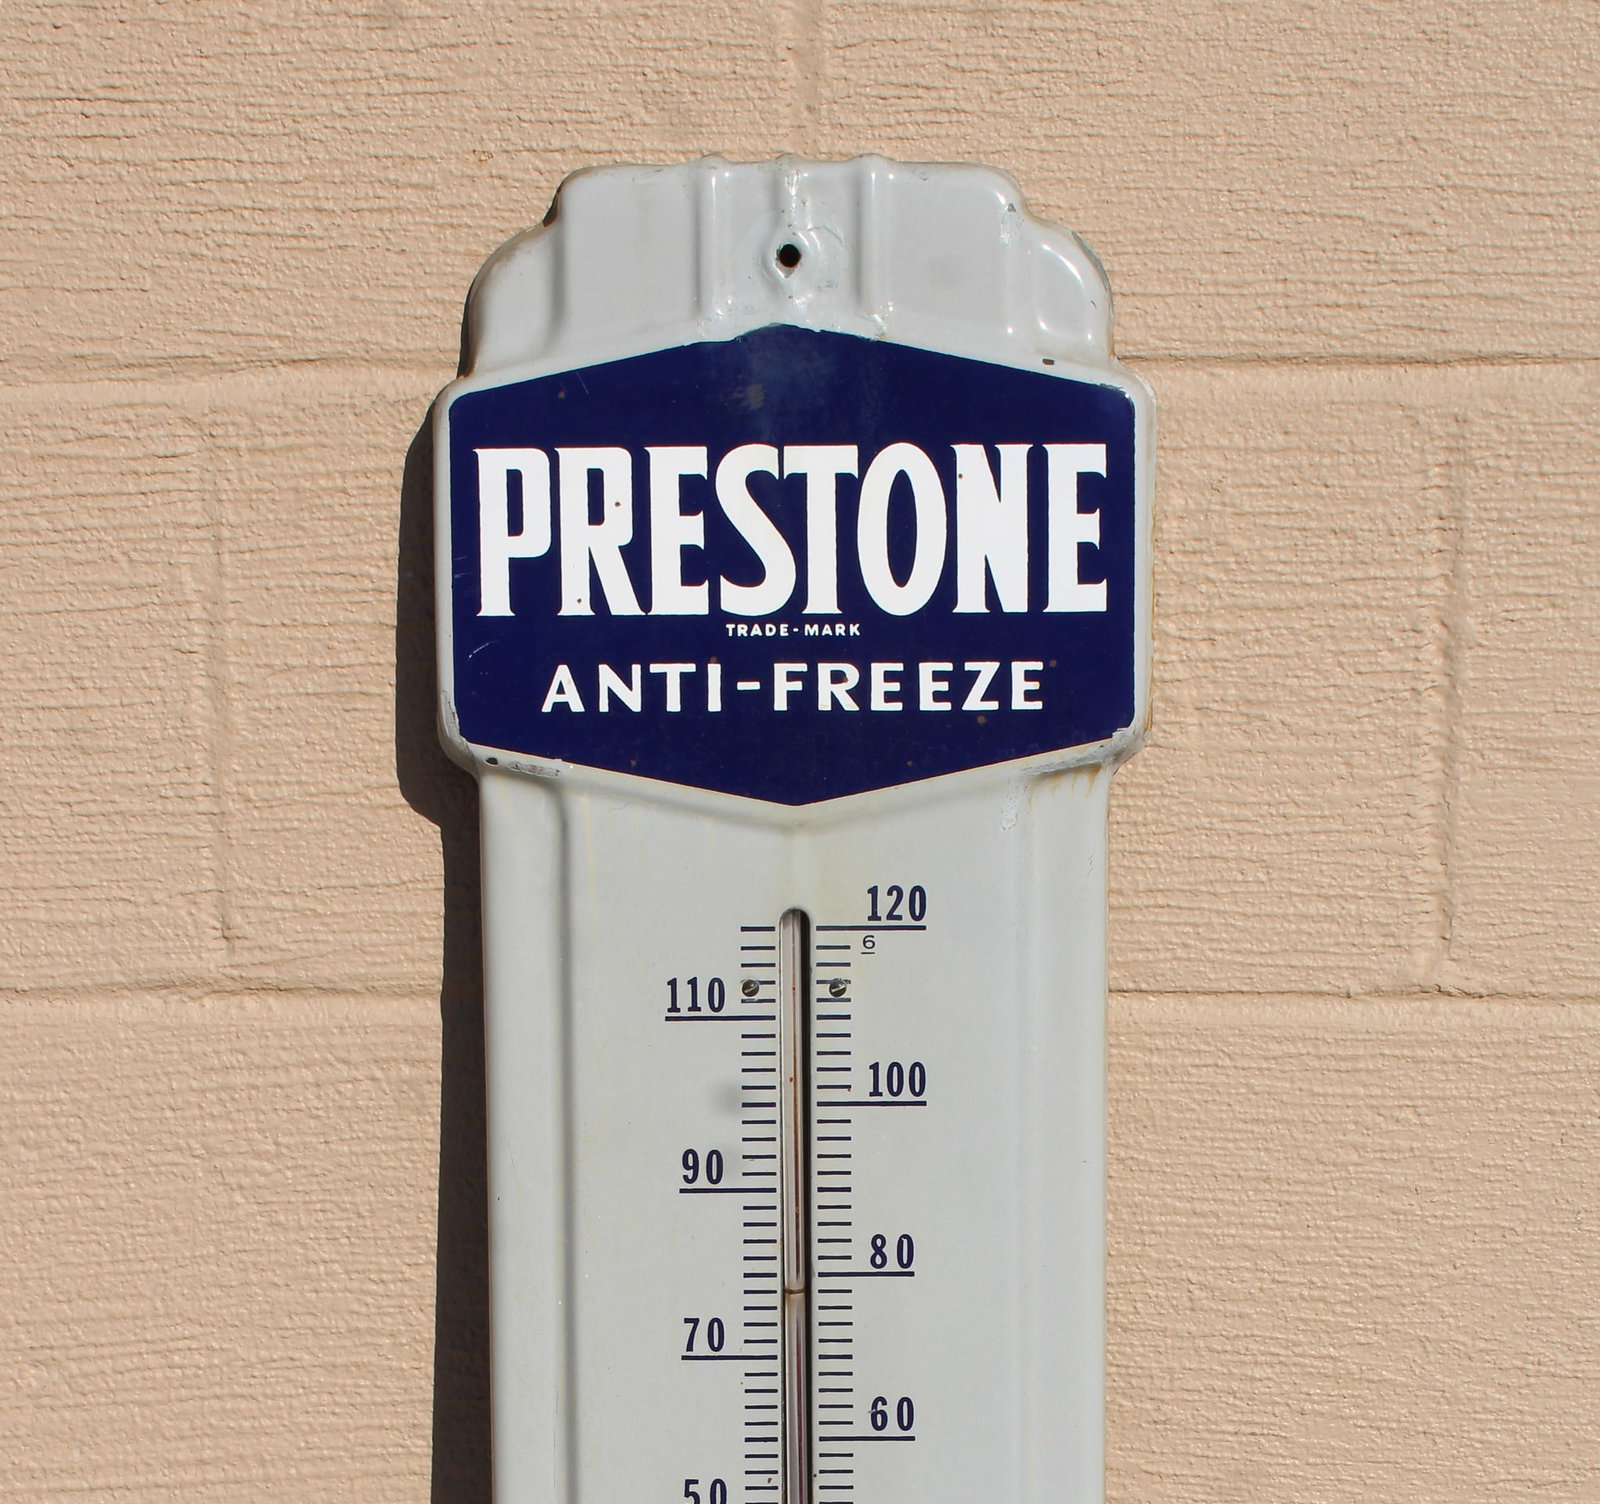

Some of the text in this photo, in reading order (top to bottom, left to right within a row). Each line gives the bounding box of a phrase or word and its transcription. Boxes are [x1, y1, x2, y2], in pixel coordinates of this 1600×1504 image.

[472, 442, 1108, 617] PRESTONE
[725, 623, 860, 637] TRADE-MARK
[541, 661, 1044, 713] ANTI-FREEZE
[867, 884, 927, 922] 120
[666, 976, 726, 1014] 110
[868, 1061, 927, 1098] 100
[681, 1148, 724, 1185] 90
[869, 1233, 915, 1270] 80
[683, 1317, 725, 1353] 70
[870, 1395, 915, 1432] 60
